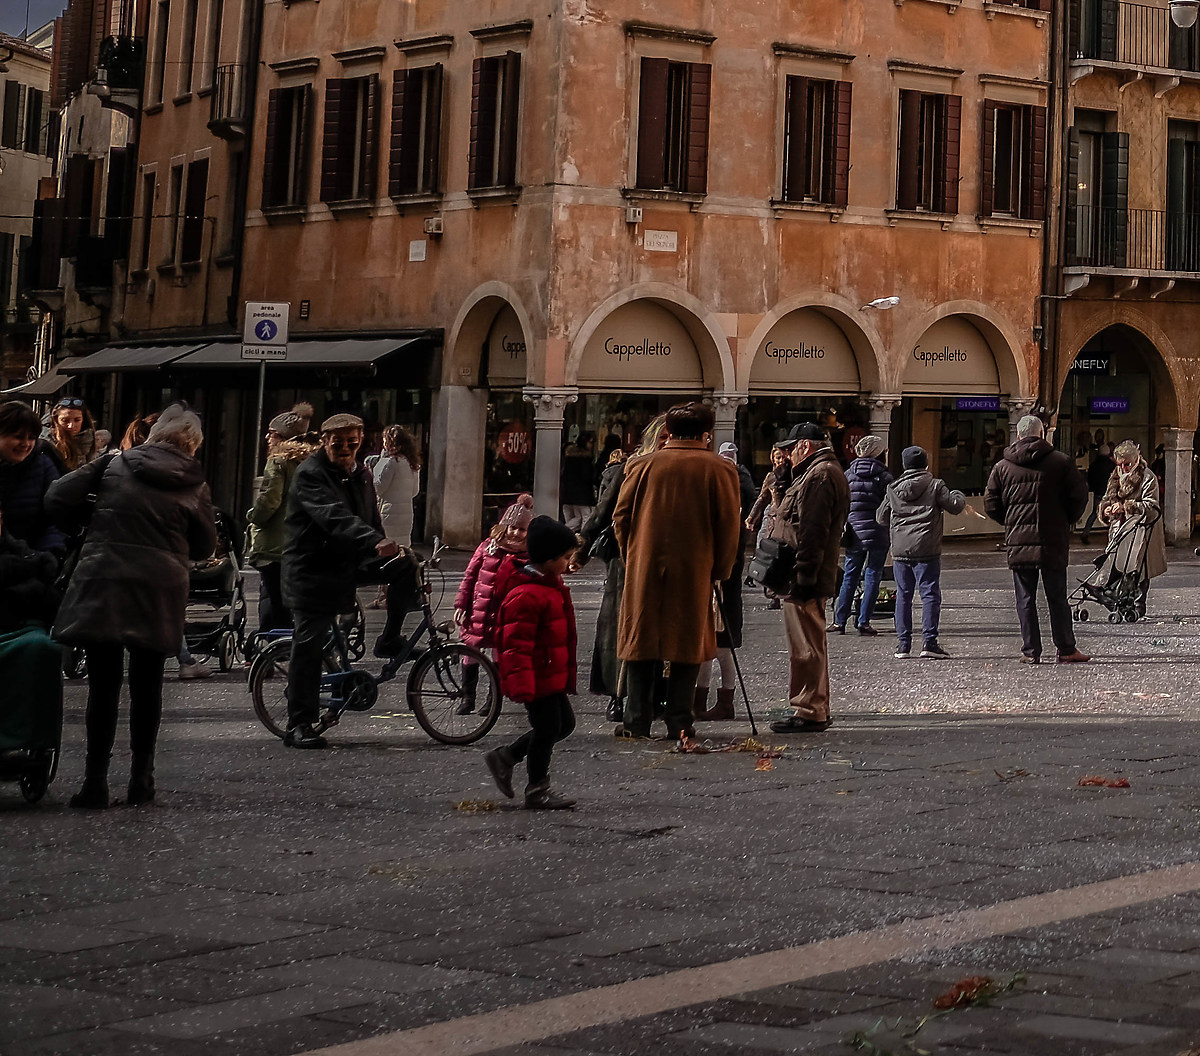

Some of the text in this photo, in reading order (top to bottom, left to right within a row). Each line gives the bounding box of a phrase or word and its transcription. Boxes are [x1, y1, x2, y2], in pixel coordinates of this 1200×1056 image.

[604, 337, 672, 362] Cappelletto
[765, 341, 825, 365] Cappelletto
[913, 345, 968, 367] Cappelletto
[958, 400, 997, 408] STONEFLY
[1093, 401, 1128, 409] STONEFLY
